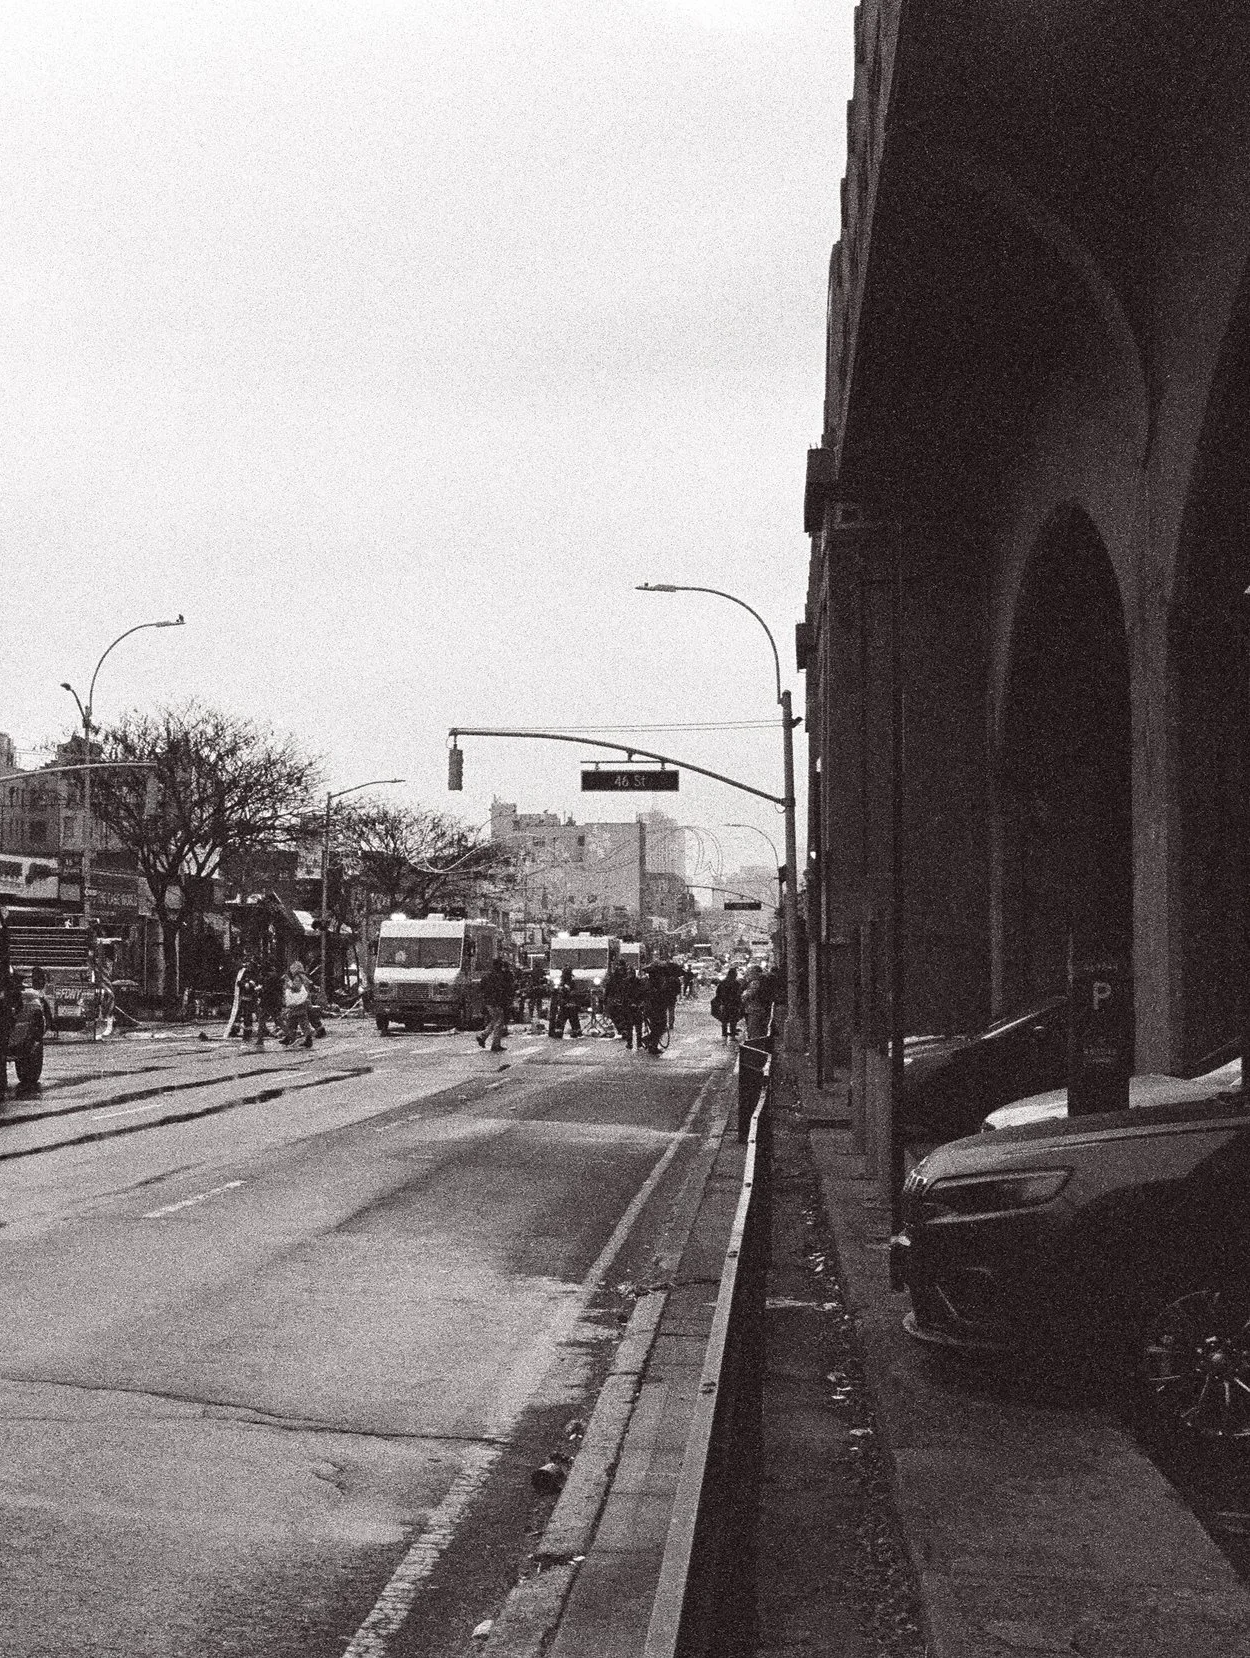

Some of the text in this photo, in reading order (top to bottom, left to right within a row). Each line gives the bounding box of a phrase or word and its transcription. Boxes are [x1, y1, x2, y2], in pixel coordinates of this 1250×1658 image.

[614, 775, 647, 787] 46 St
[1092, 981, 1112, 1011] P
